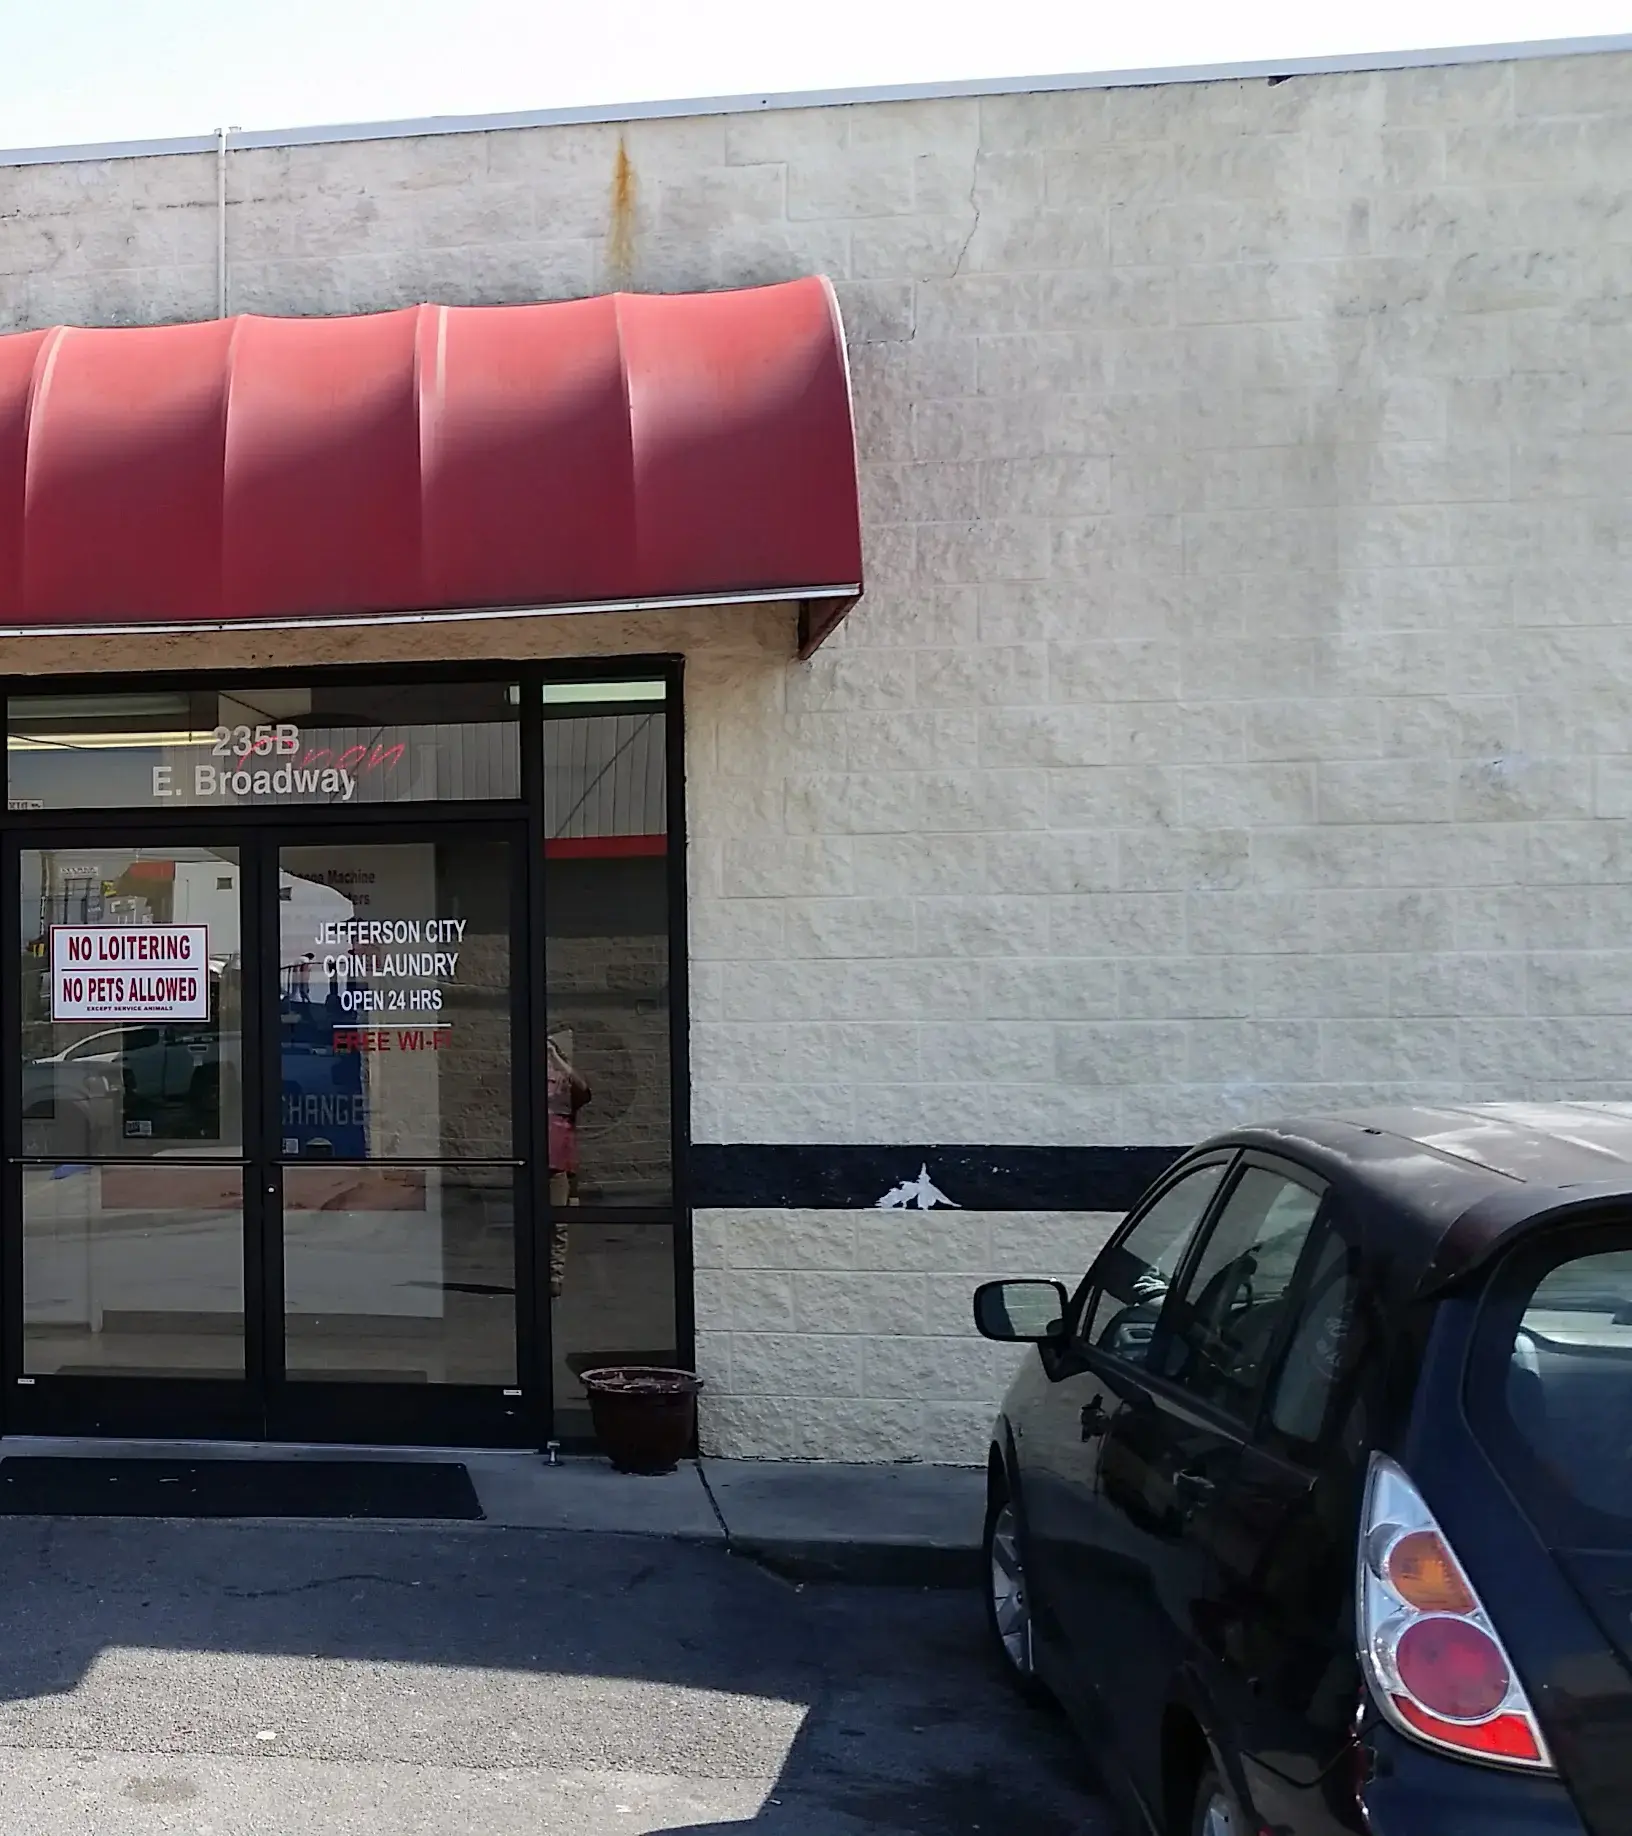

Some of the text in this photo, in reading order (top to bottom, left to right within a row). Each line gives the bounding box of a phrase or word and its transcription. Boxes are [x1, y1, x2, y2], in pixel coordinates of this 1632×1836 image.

[211, 724, 300, 756] 235B
[152, 762, 356, 800] E. Broadway
[327, 868, 376, 884] Machine
[314, 919, 467, 945] JEFFERSON CITY
[68, 935, 191, 960] NO LOITERING
[323, 952, 459, 978] COIN LAUNDRY
[63, 977, 197, 1002] NO PETS ALLOWED
[340, 989, 443, 1011] OPEN 24 HRS
[333, 1030, 453, 1054] FREE WI-FI
